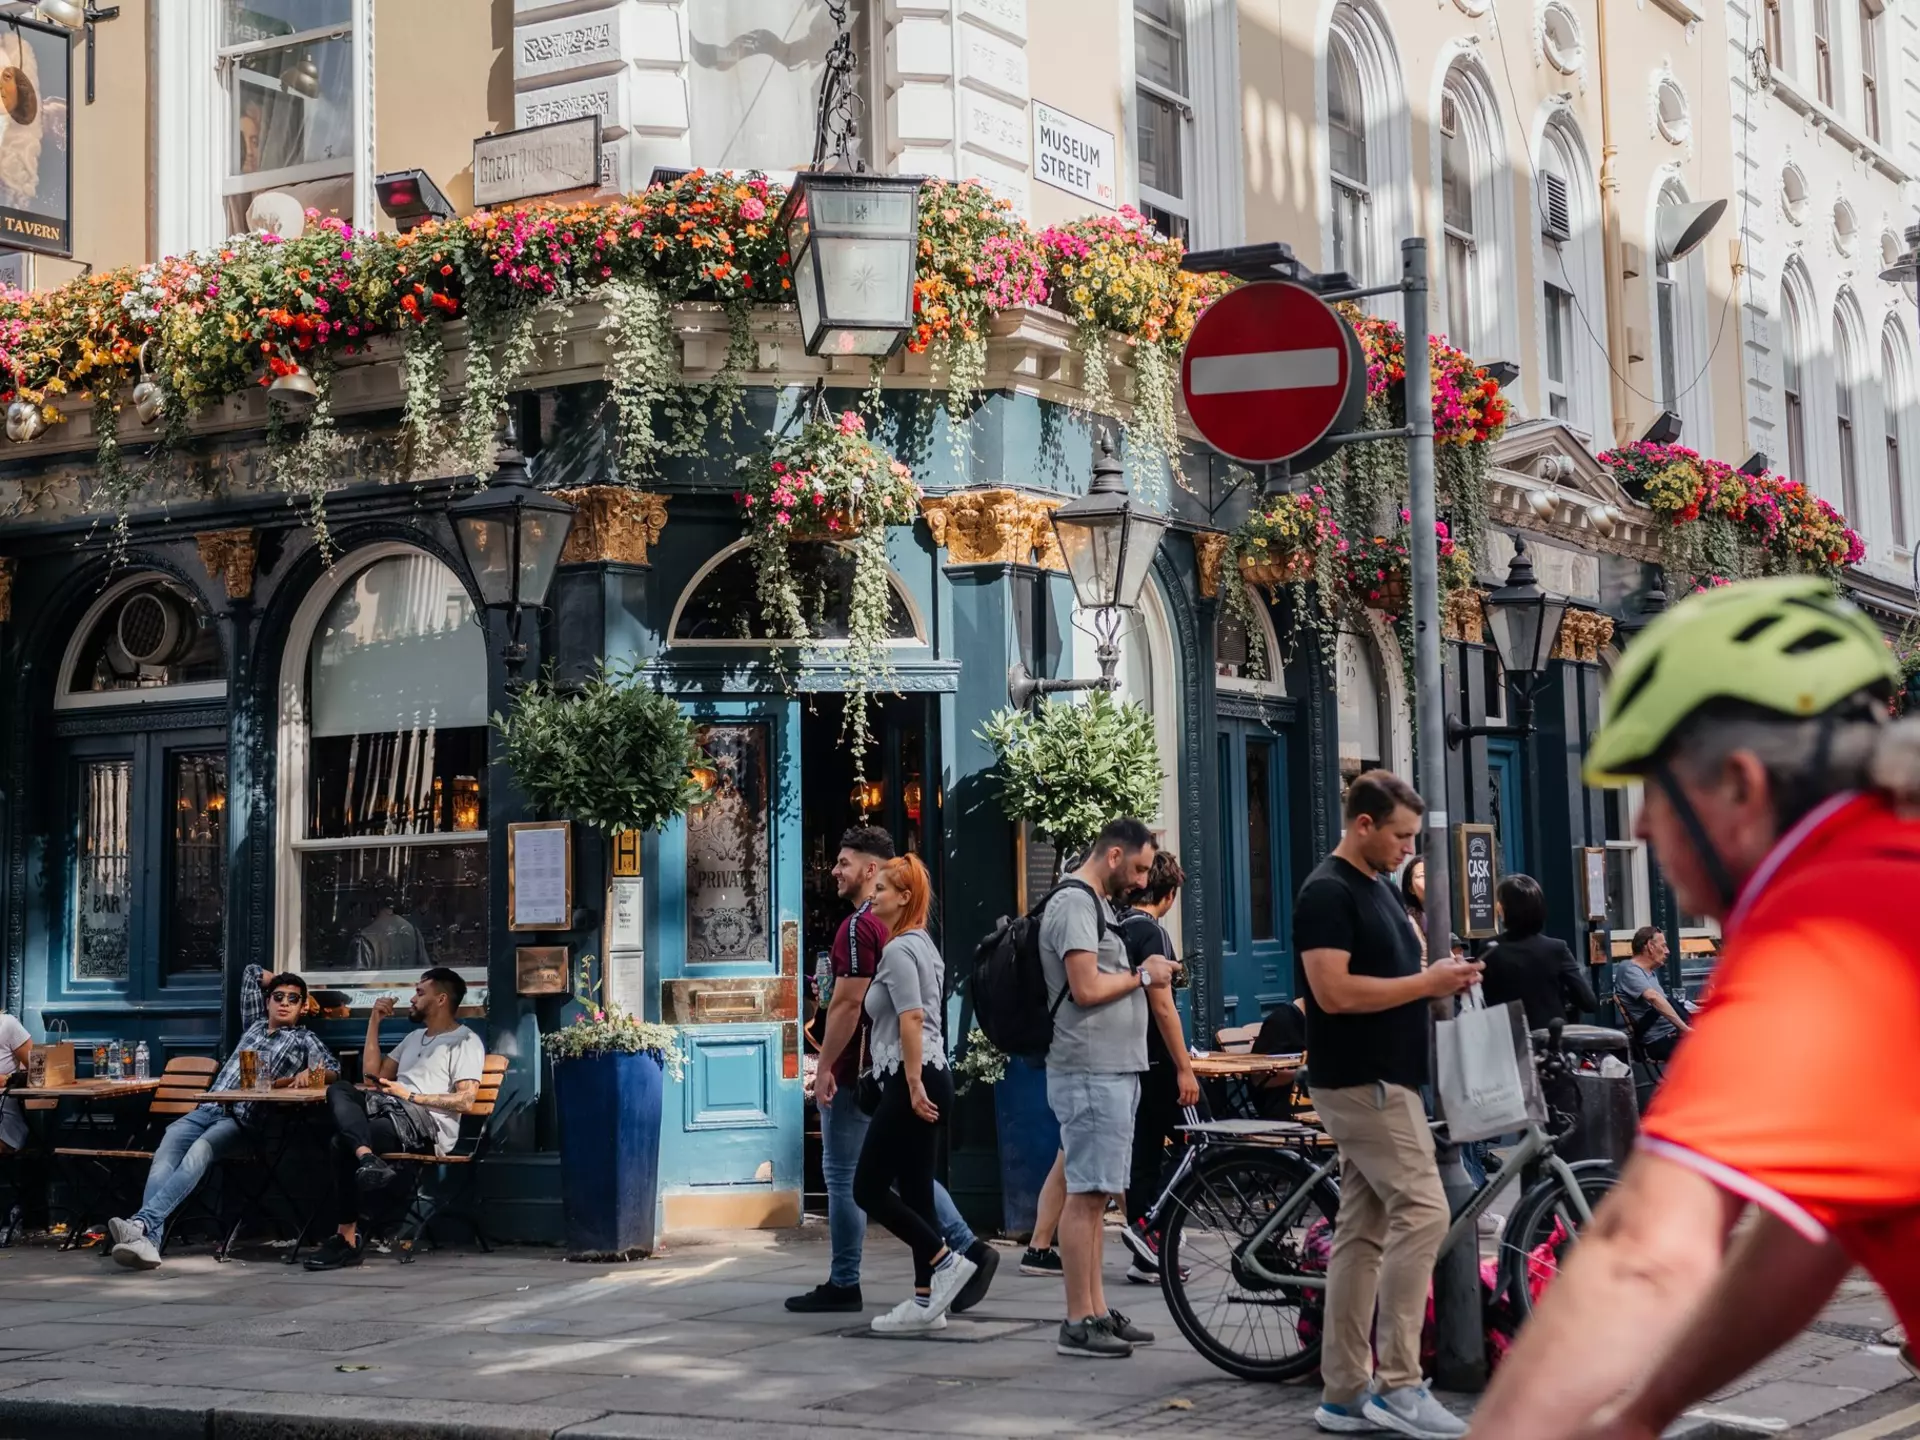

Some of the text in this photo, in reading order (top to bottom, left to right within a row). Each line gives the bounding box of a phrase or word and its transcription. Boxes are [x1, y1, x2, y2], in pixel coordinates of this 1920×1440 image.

[1040, 124, 1100, 168] MUSEUM
[480, 153, 516, 183] GREAT
[1041, 152, 1091, 190] STREET
[1096, 183, 1113, 200] WC1
[4, 216, 60, 241] TAVERN
[1468, 859, 1490, 878] CASK
[93, 894, 120, 913] BAR
